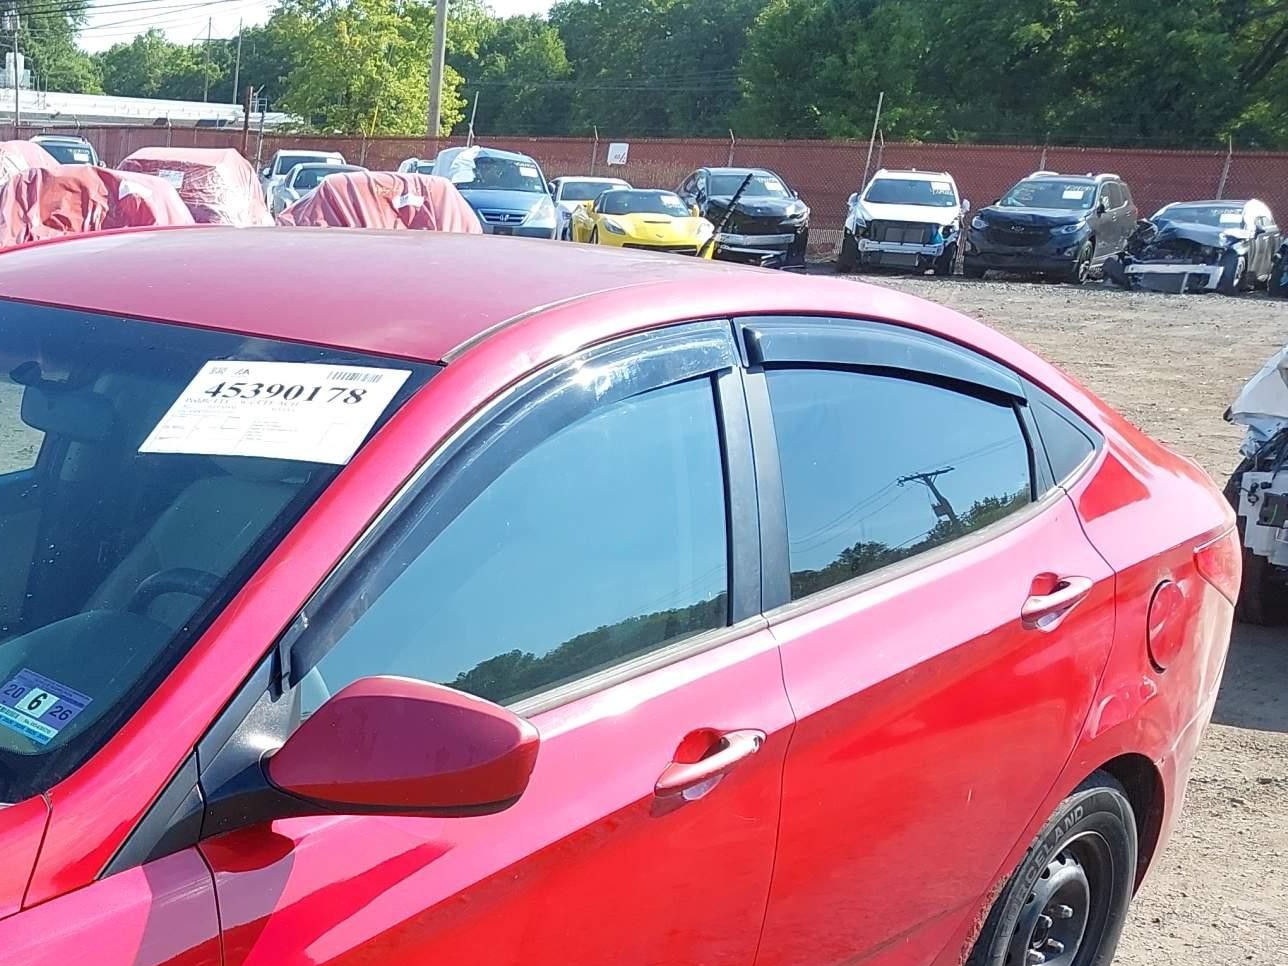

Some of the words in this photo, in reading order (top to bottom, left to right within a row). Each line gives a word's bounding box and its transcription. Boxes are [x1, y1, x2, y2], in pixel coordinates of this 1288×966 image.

[204, 380, 368, 405] 45390178
[3, 683, 26, 699] 20
[27, 692, 49, 711] 6
[48, 705, 73, 721] 26
[1001, 805, 1085, 938] FORCELAND
